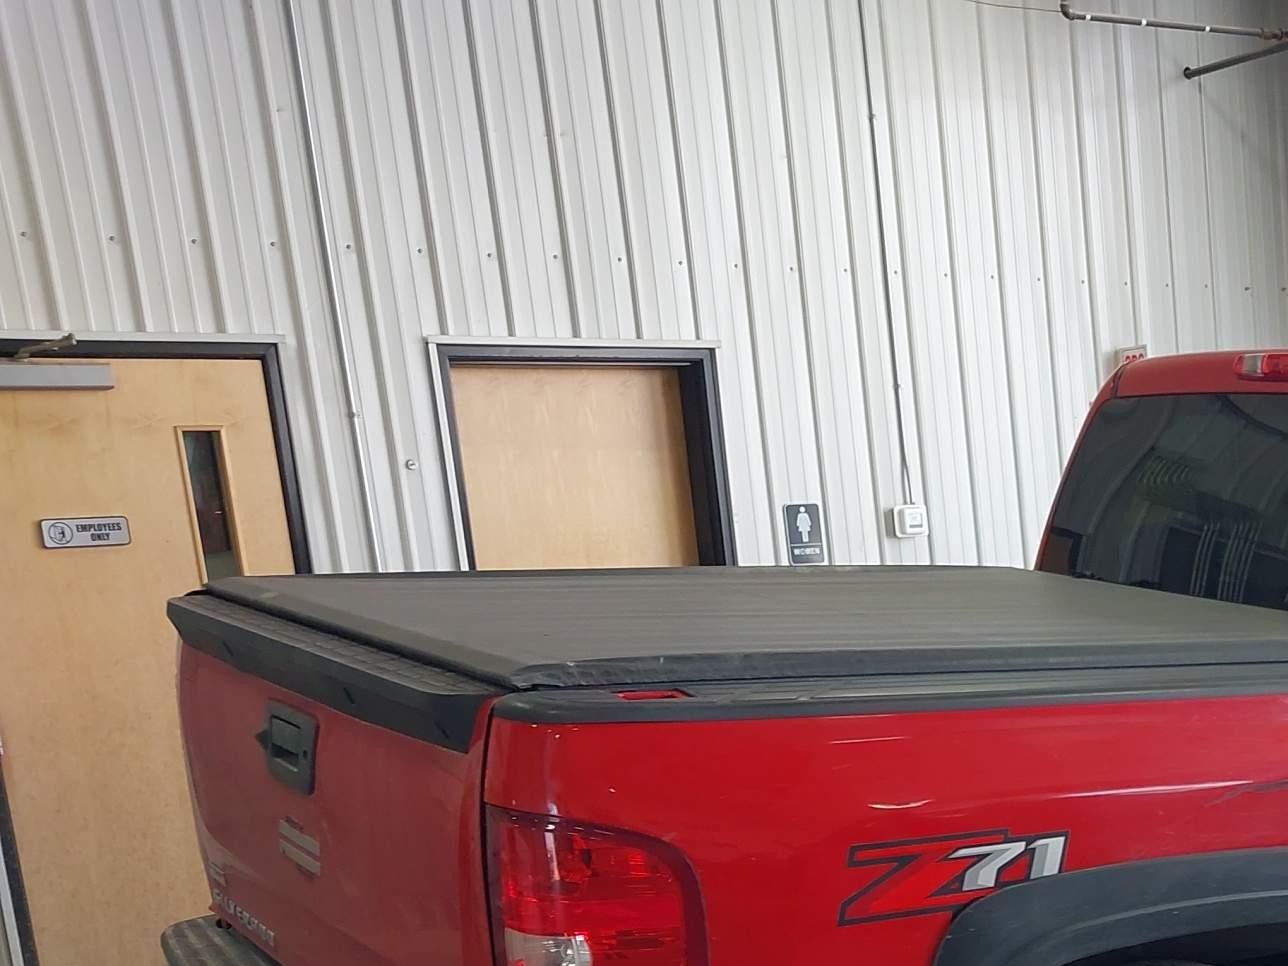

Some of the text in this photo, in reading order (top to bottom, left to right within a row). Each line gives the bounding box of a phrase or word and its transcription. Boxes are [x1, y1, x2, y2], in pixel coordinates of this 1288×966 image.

[76, 523, 121, 532] EMPLOYEES
[90, 533, 110, 541] ONLY
[837, 829, 1069, 927] Z71
